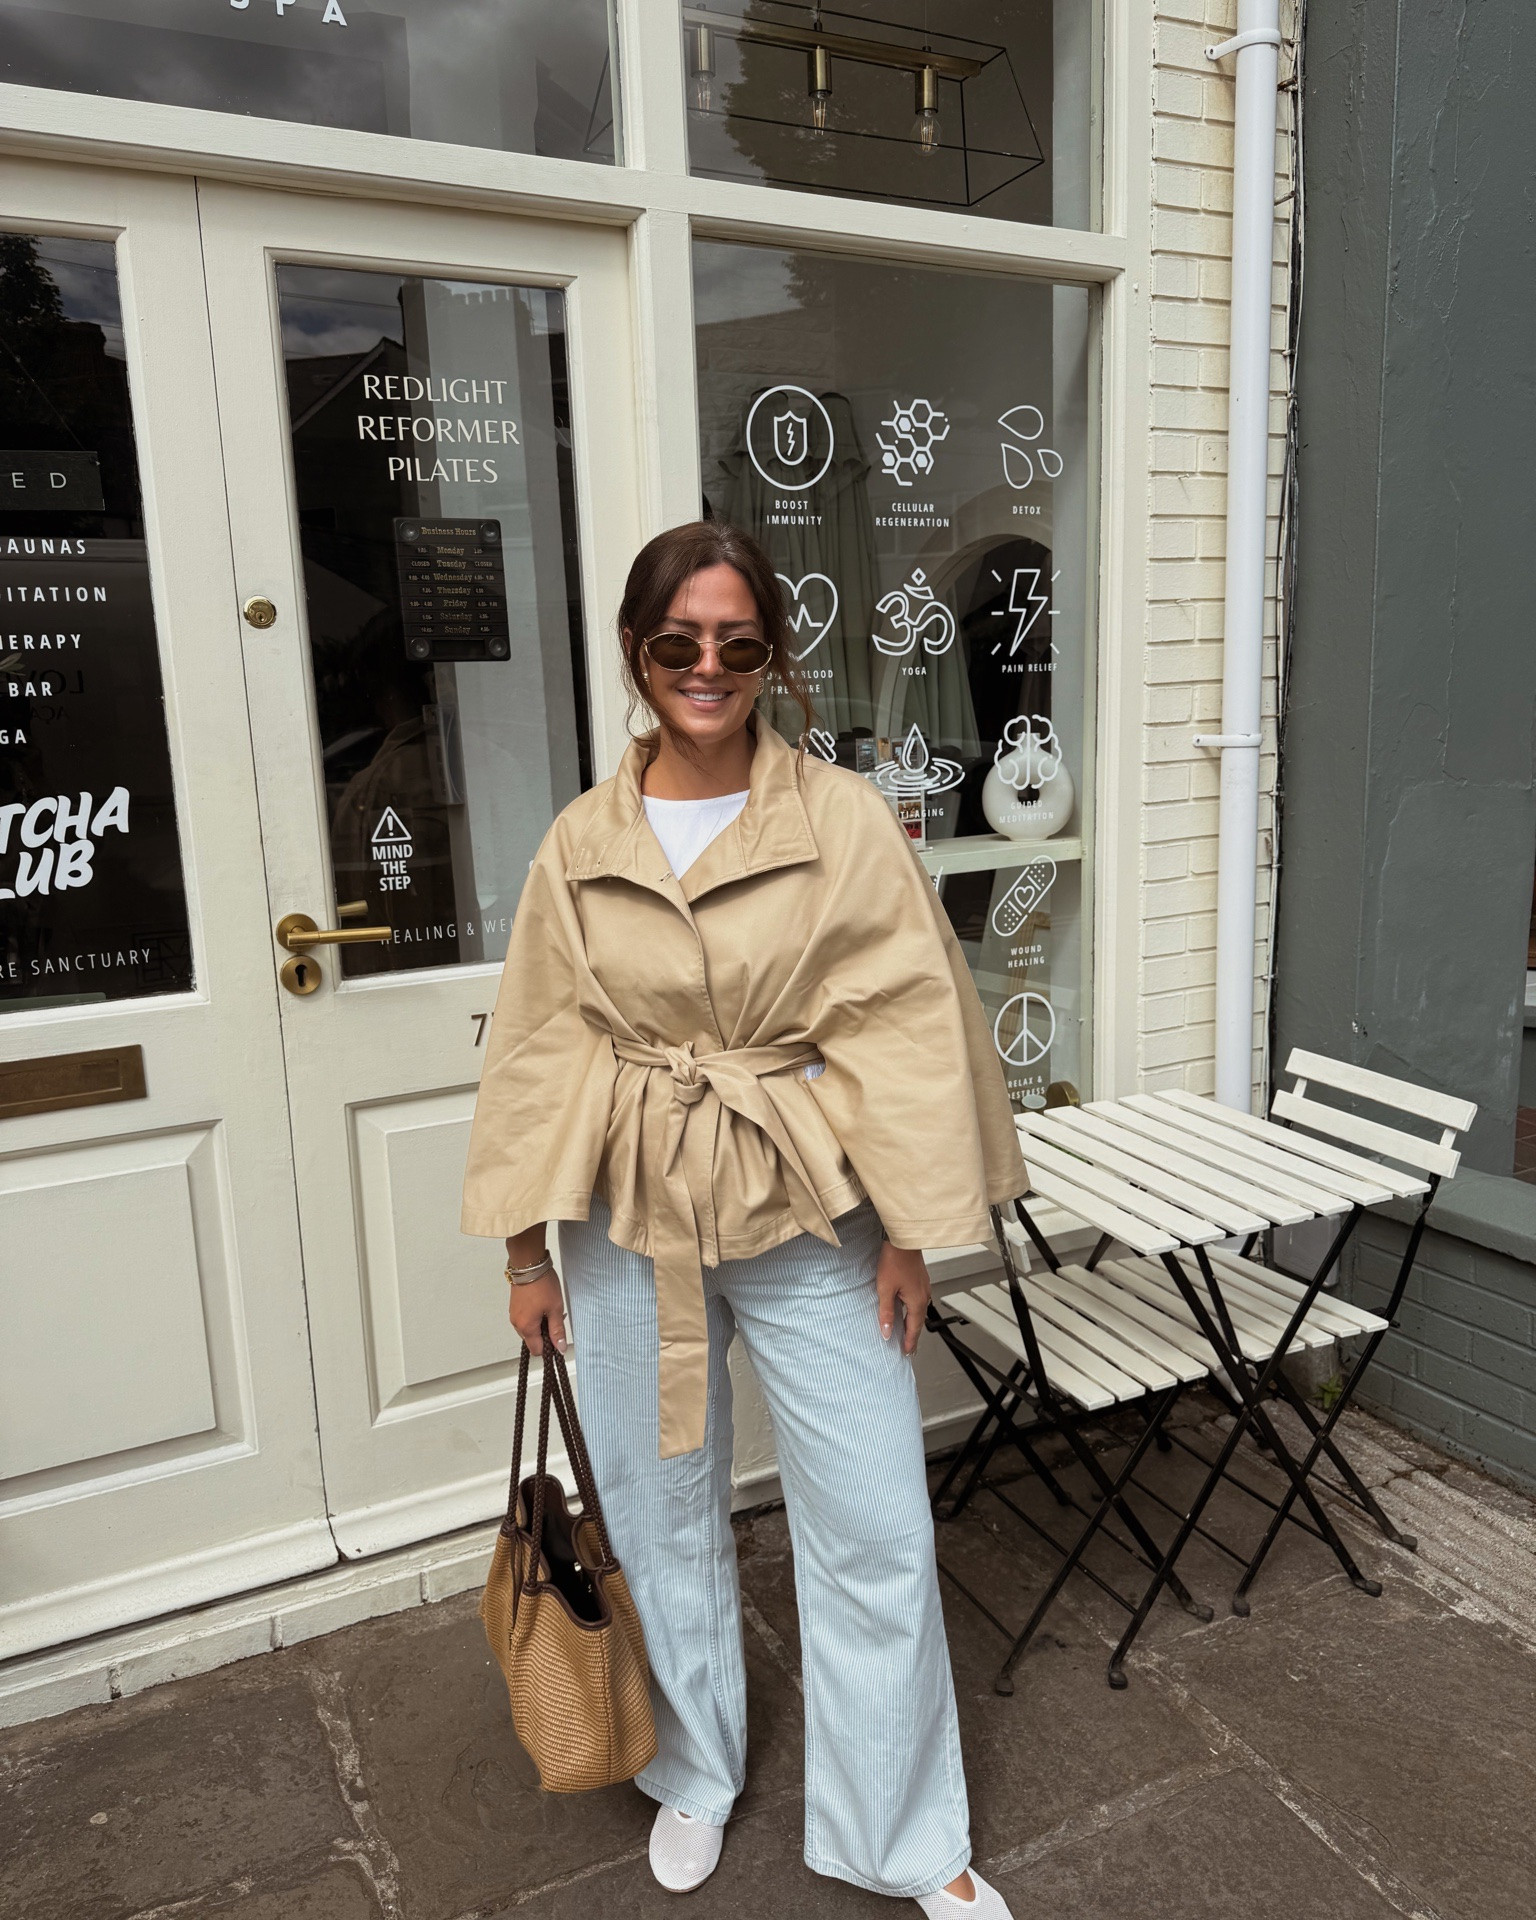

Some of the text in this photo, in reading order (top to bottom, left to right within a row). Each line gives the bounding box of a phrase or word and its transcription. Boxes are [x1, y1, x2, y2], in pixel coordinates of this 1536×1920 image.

[363, 374, 508, 405] REDLIGHT
[357, 415, 520, 445] REFORMER
[388, 456, 498, 484] PILATES
[774, 500, 809, 510] BOOST
[891, 503, 935, 513] CELLULAR
[1012, 505, 1041, 515] DETOX
[766, 515, 822, 526] IMMUNITY
[875, 517, 950, 528] REGENERATION
[421, 526, 476, 536] Business Hours
[0, 538, 86, 554] AUNAS
[436, 547, 465, 556] Monday
[436, 560, 467, 569] Tuesday
[433, 573, 472, 582] Wednesday
[0, 587, 107, 602] ITATION
[436, 586, 471, 595] Thursday
[443, 600, 468, 609] Friday
[440, 613, 472, 621] Saturday
[444, 626, 471, 634] Sunday
[901, 666, 927, 676] YOGA
[1001, 662, 1058, 673] PAIN RELIEF
[8, 681, 53, 697] BAR
[0, 728, 27, 745] GA
[1010, 800, 1043, 810] GUIDED
[897, 808, 944, 820] TI-AGING
[999, 811, 1054, 823] MEDITATION
[372, 843, 413, 860] MIND
[381, 860, 407, 875] THE
[379, 875, 412, 891] STEP
[467, 921, 474, 936] &
[1010, 944, 1042, 956] WOUND
[30, 948, 150, 976] SANCTUARY
[1008, 956, 1045, 969] HEALING
[1007, 1075, 1042, 1088] RELAX &
